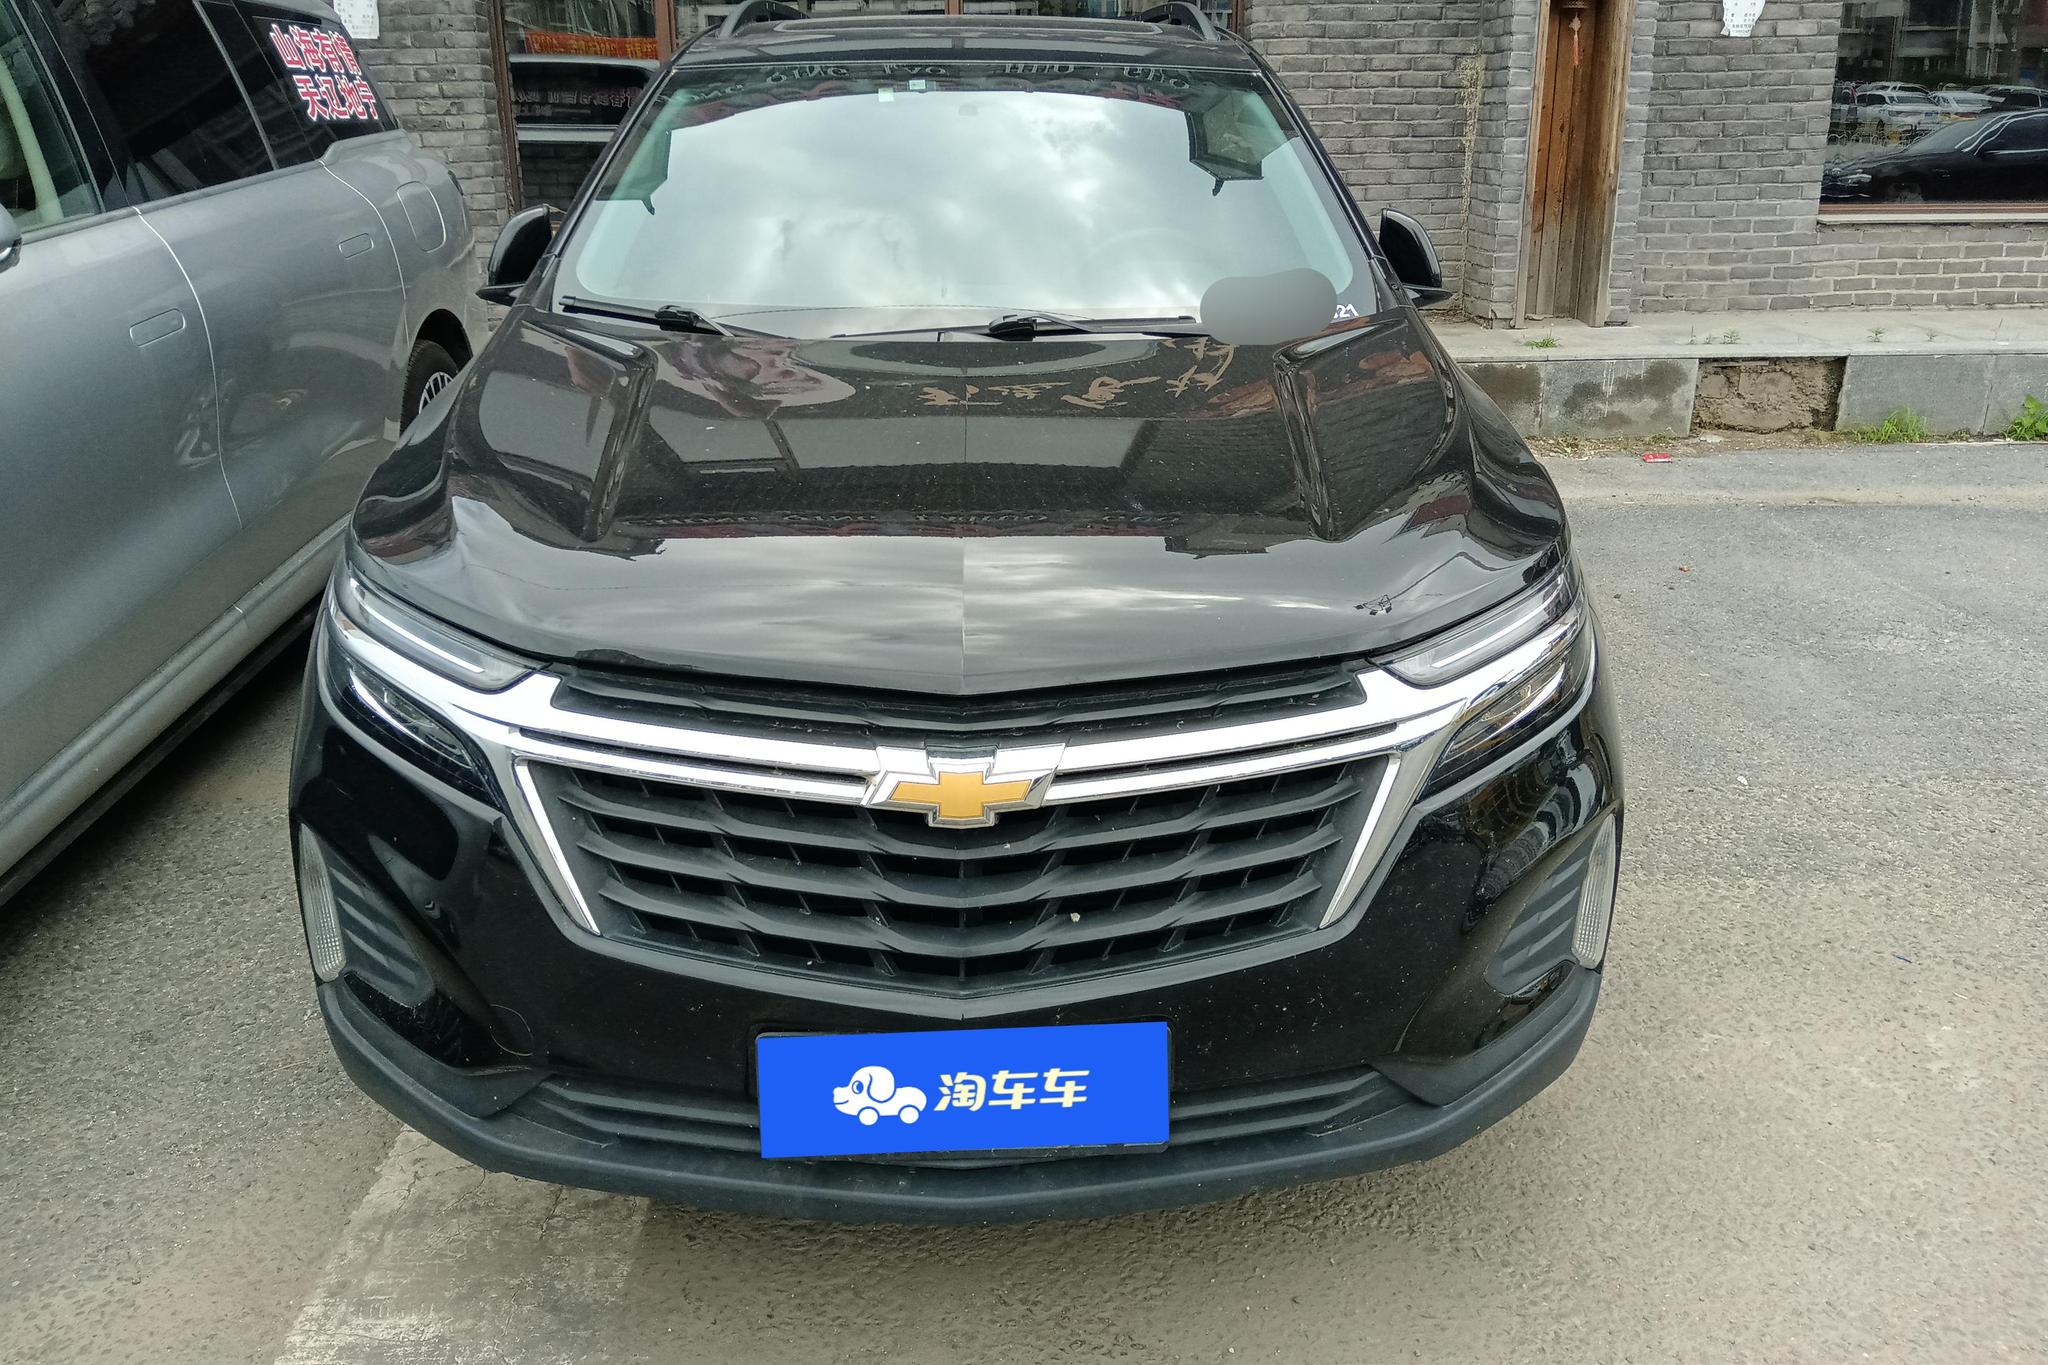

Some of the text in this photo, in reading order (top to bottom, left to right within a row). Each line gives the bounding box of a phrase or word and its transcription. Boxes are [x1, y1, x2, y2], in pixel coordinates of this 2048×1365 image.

[269, 23, 363, 76] 山海有情
[292, 73, 379, 122] 天辽地宁
